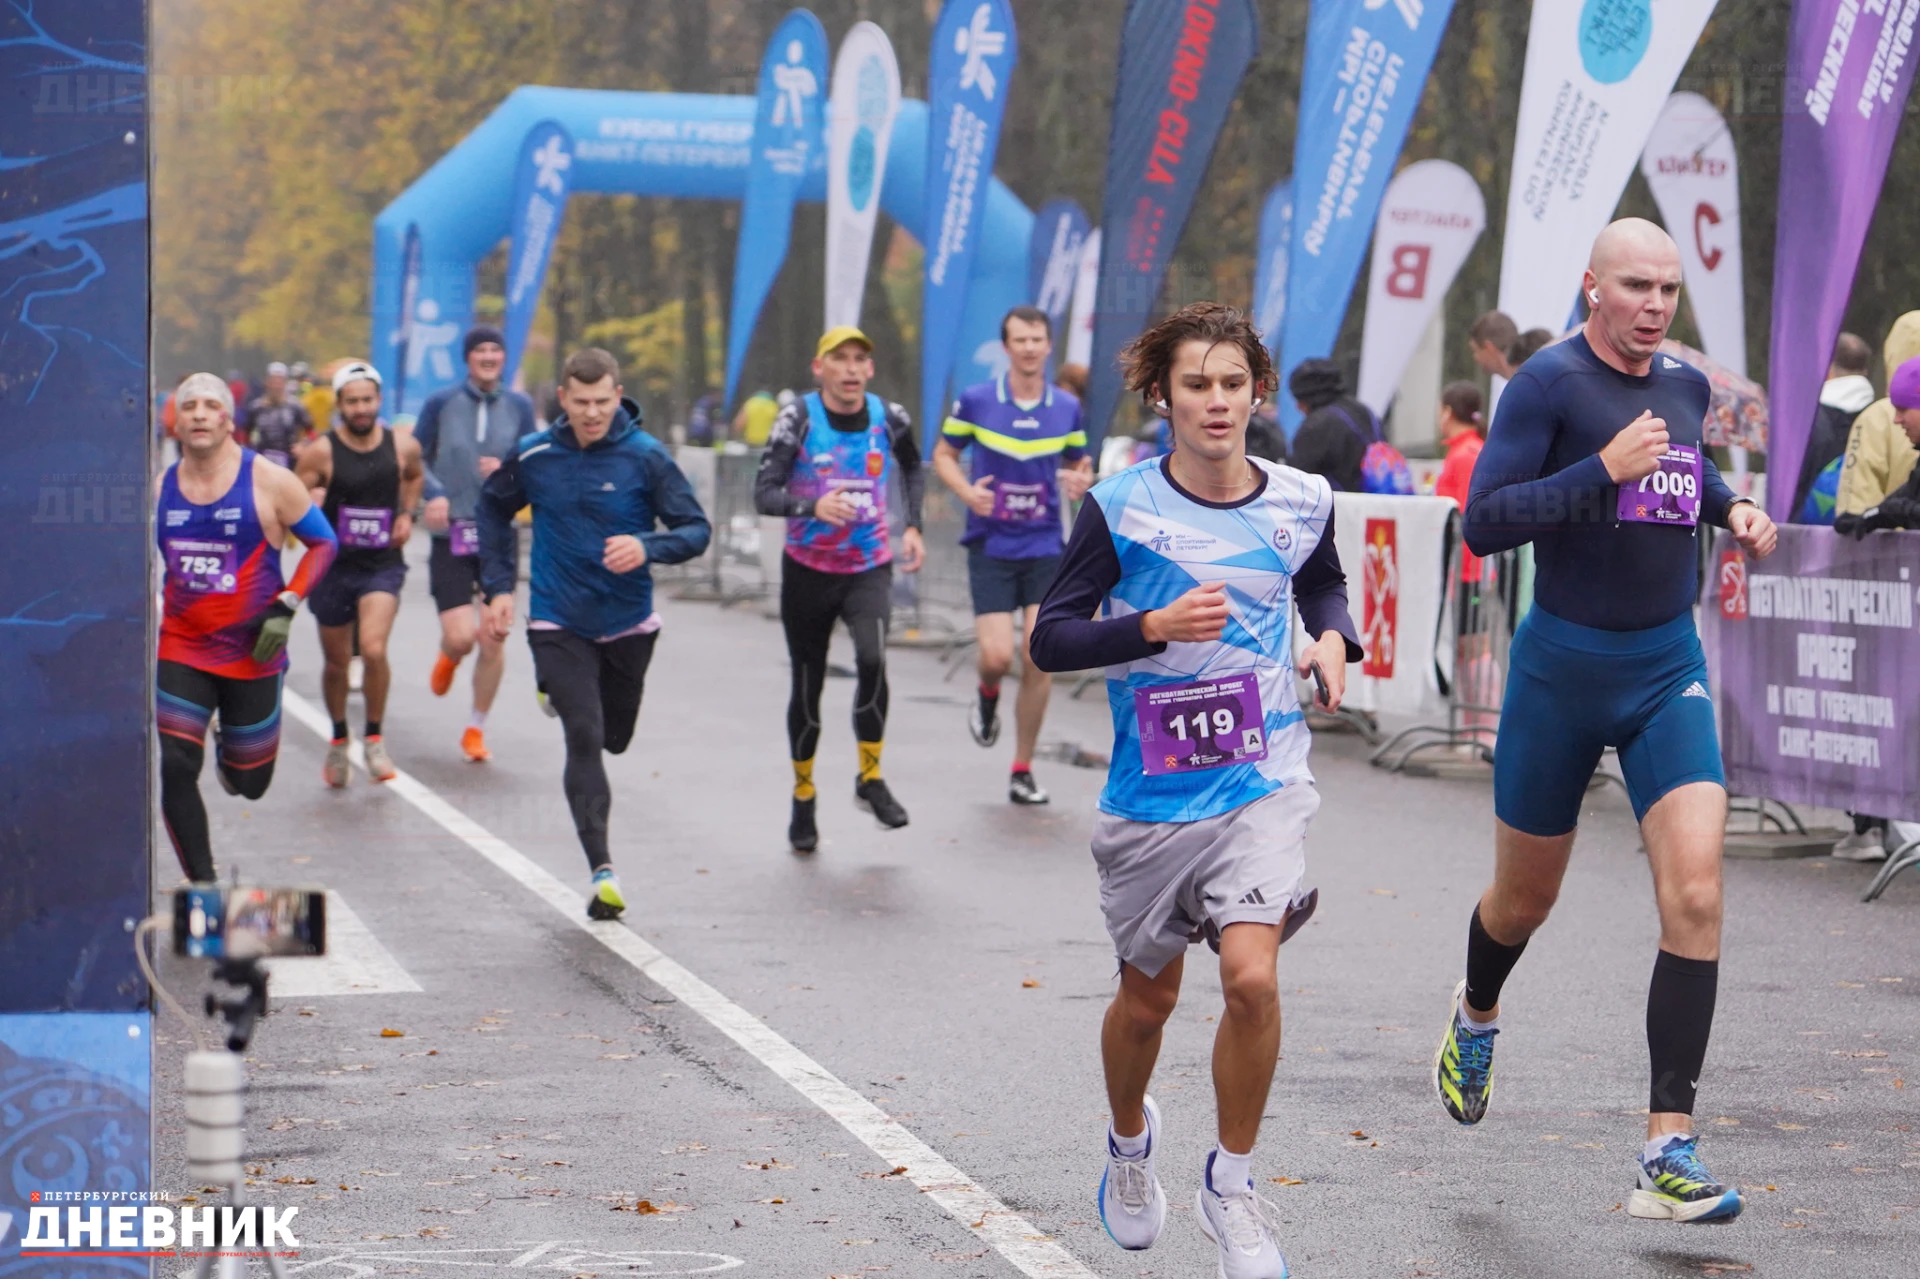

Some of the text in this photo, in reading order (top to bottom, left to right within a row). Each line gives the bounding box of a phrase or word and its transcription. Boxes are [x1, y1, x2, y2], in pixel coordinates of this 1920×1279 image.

[1638, 470, 1697, 498] 7009
[180, 556, 221, 575] 752
[1169, 708, 1235, 741] 119
